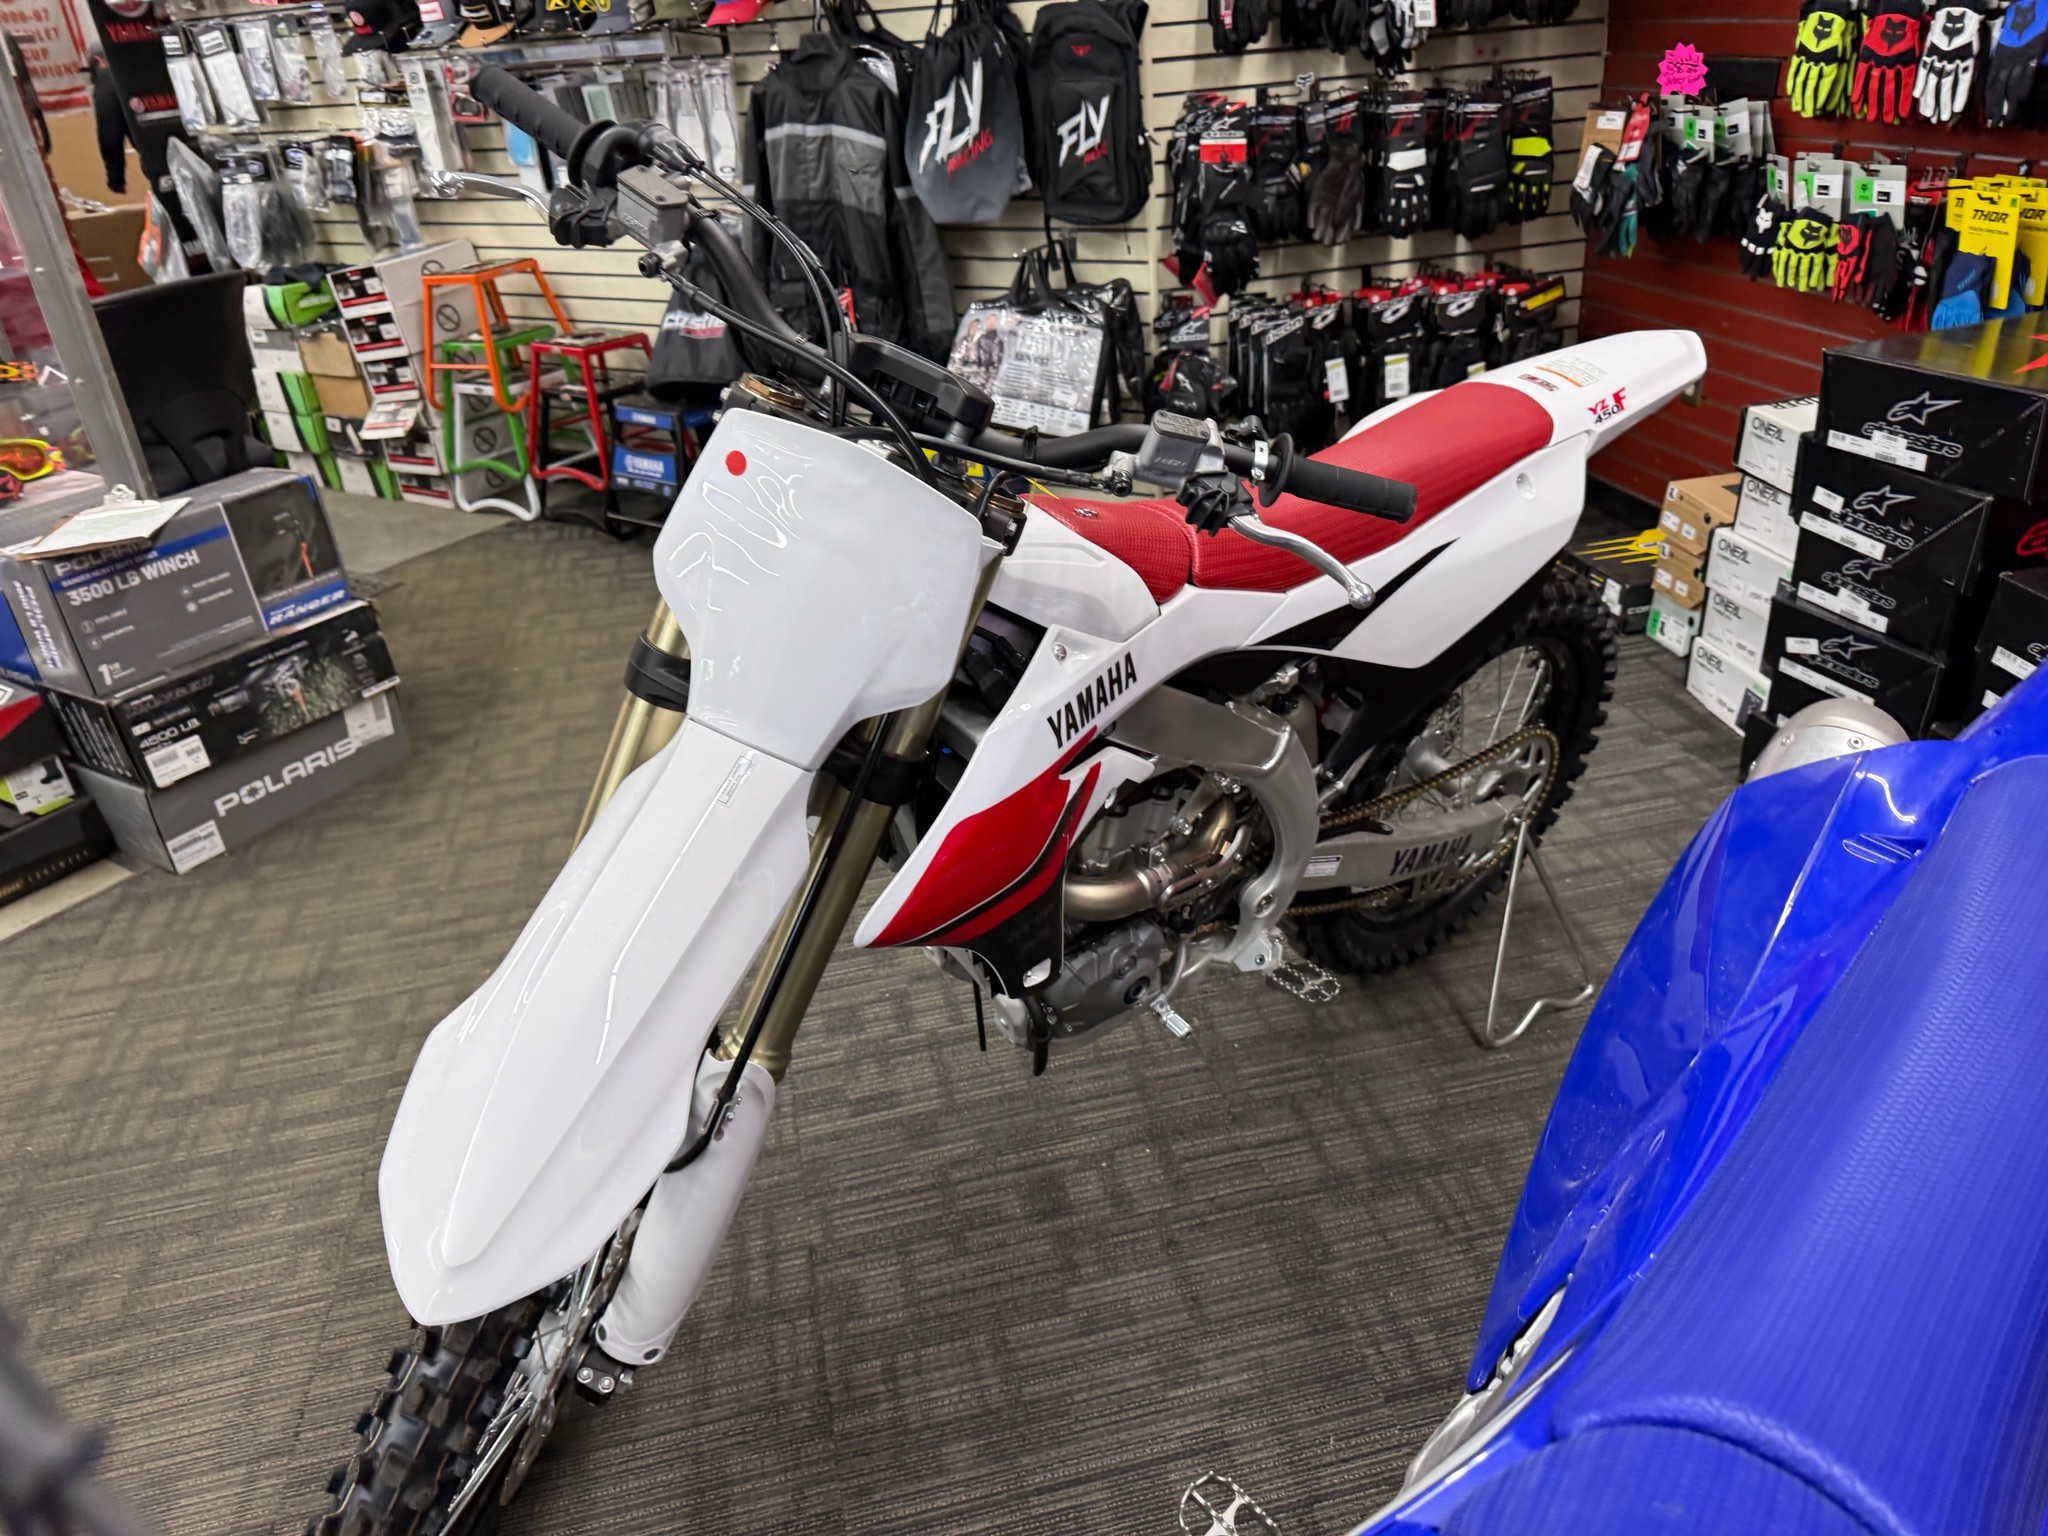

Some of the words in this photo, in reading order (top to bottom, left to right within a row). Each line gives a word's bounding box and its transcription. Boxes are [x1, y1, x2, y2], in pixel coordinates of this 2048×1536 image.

[918, 57, 983, 174] FLY
[1056, 94, 1110, 168] FLY
[1972, 209, 2008, 224] THOR
[1594, 404, 1620, 425] 450
[67, 579, 115, 606] 3500
[116, 571, 142, 590] LB
[140, 549, 200, 580] WINCH
[1047, 651, 1138, 749] YAMAHA
[139, 726, 180, 749] 4500
[214, 736, 357, 818] POLARIS
[1389, 832, 1472, 877] YAMAHA
